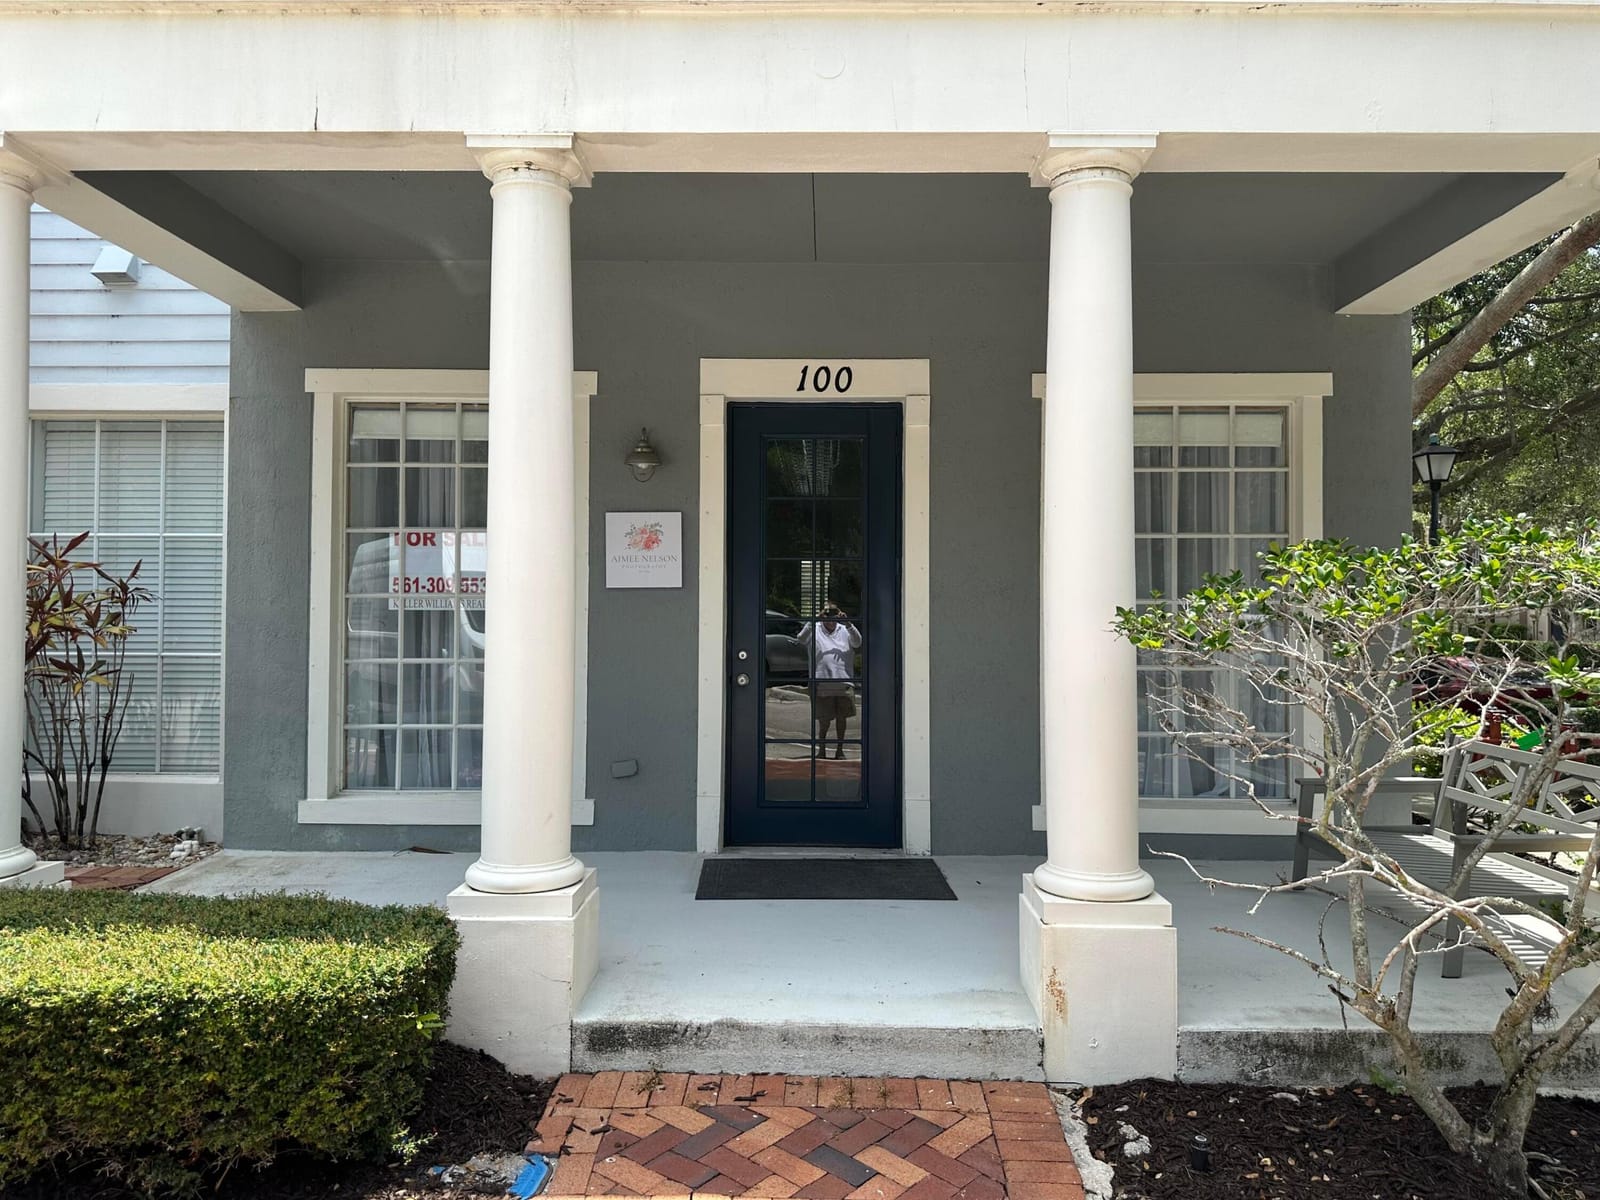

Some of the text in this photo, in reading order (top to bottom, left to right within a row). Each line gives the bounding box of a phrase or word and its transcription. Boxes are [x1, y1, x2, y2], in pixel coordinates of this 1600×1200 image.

[796, 365, 853, 393] 100
[444, 532, 487, 547] SAL
[392, 576, 487, 594] 561-309553
[393, 599, 425, 609] KLLER
[425, 599, 466, 609] WILLIAS
